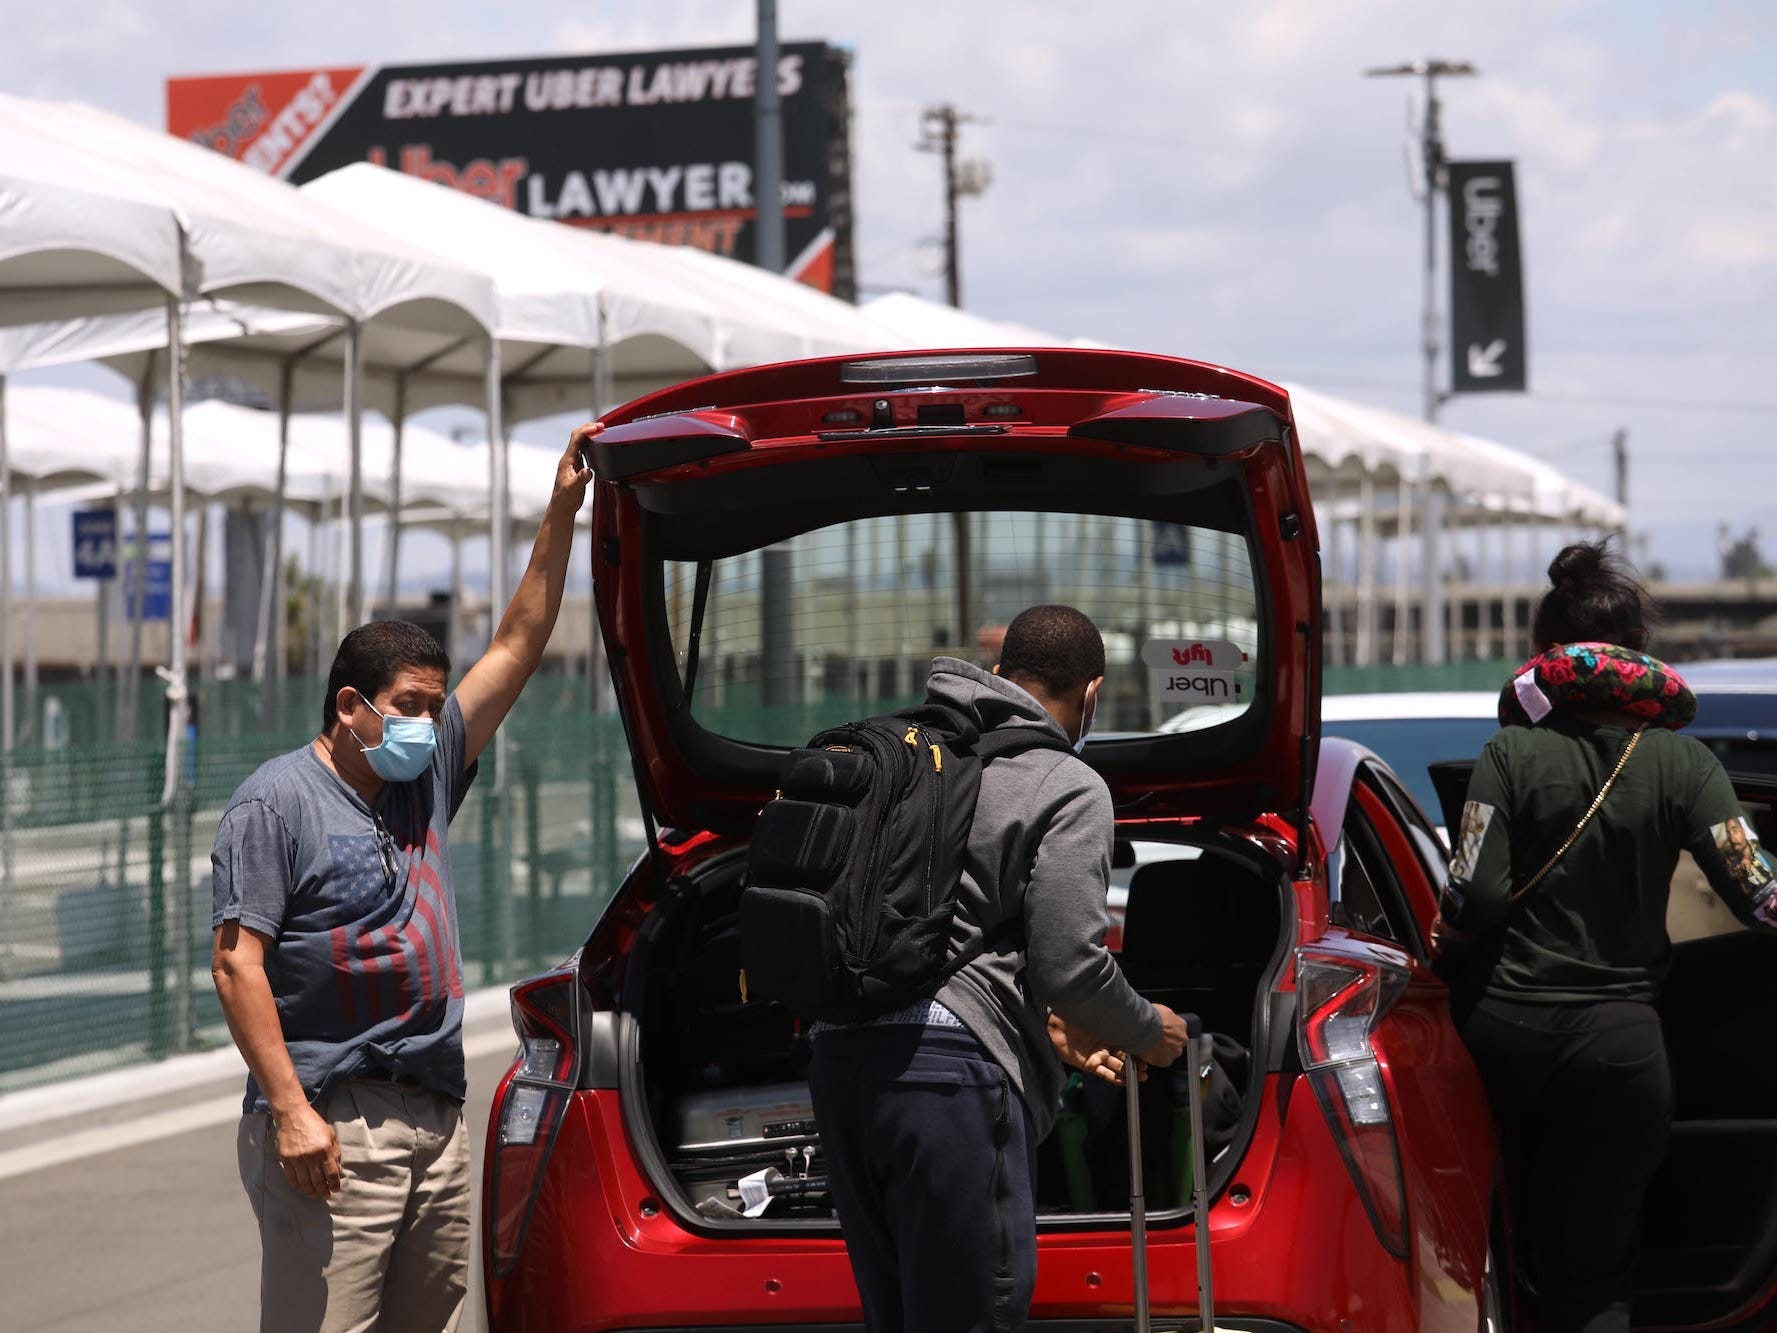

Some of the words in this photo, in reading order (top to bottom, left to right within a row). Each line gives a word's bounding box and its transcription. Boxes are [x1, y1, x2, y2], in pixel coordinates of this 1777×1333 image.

[384, 72, 522, 119] EXPERT
[524, 66, 625, 111] UBER
[626, 55, 803, 105] LAWYES
[528, 162, 754, 218] LAWYER
[1464, 176, 1503, 277] Uber
[1172, 643, 1213, 666] lyft
[1166, 676, 1229, 697] Uber
